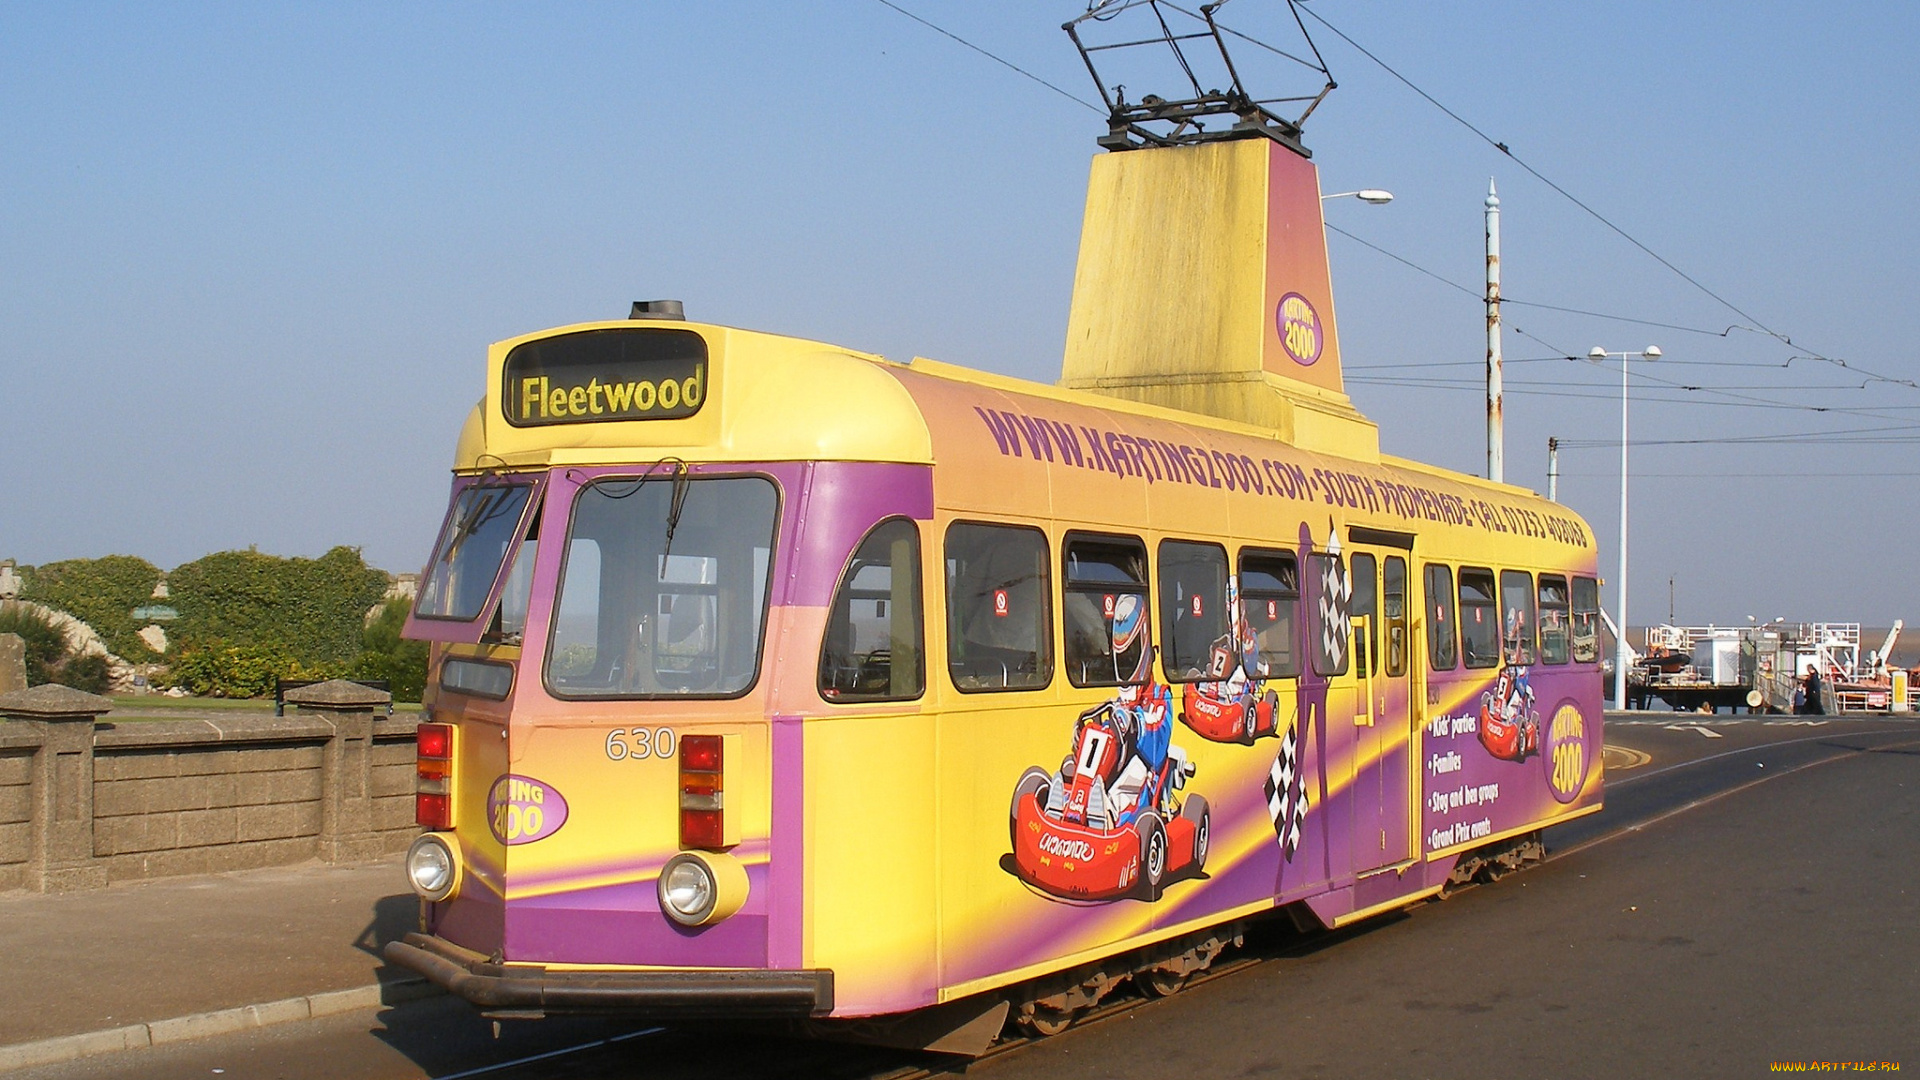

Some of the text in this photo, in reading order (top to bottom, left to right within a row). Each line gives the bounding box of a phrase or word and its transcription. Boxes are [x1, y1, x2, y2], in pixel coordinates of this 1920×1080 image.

[1285, 320, 1315, 360] 2000
[521, 363, 704, 420] Fleetwood
[974, 406, 1588, 549] WWW.KARTING2000.COM SOUTH PROMENADE CALL 01253 408068
[1214, 655, 1224, 672] 2
[1499, 681, 1506, 695] 3
[1451, 712, 1476, 740] parties
[1552, 704, 1583, 743] KARTING
[605, 725, 676, 761] 630
[1085, 737, 1099, 769] 1
[1432, 751, 1462, 777] Families
[1552, 742, 1582, 794] 2000
[1432, 782, 1499, 815] Stag and hen groups
[494, 803, 544, 840] 2000
[1431, 816, 1491, 850] Grand Prix events
